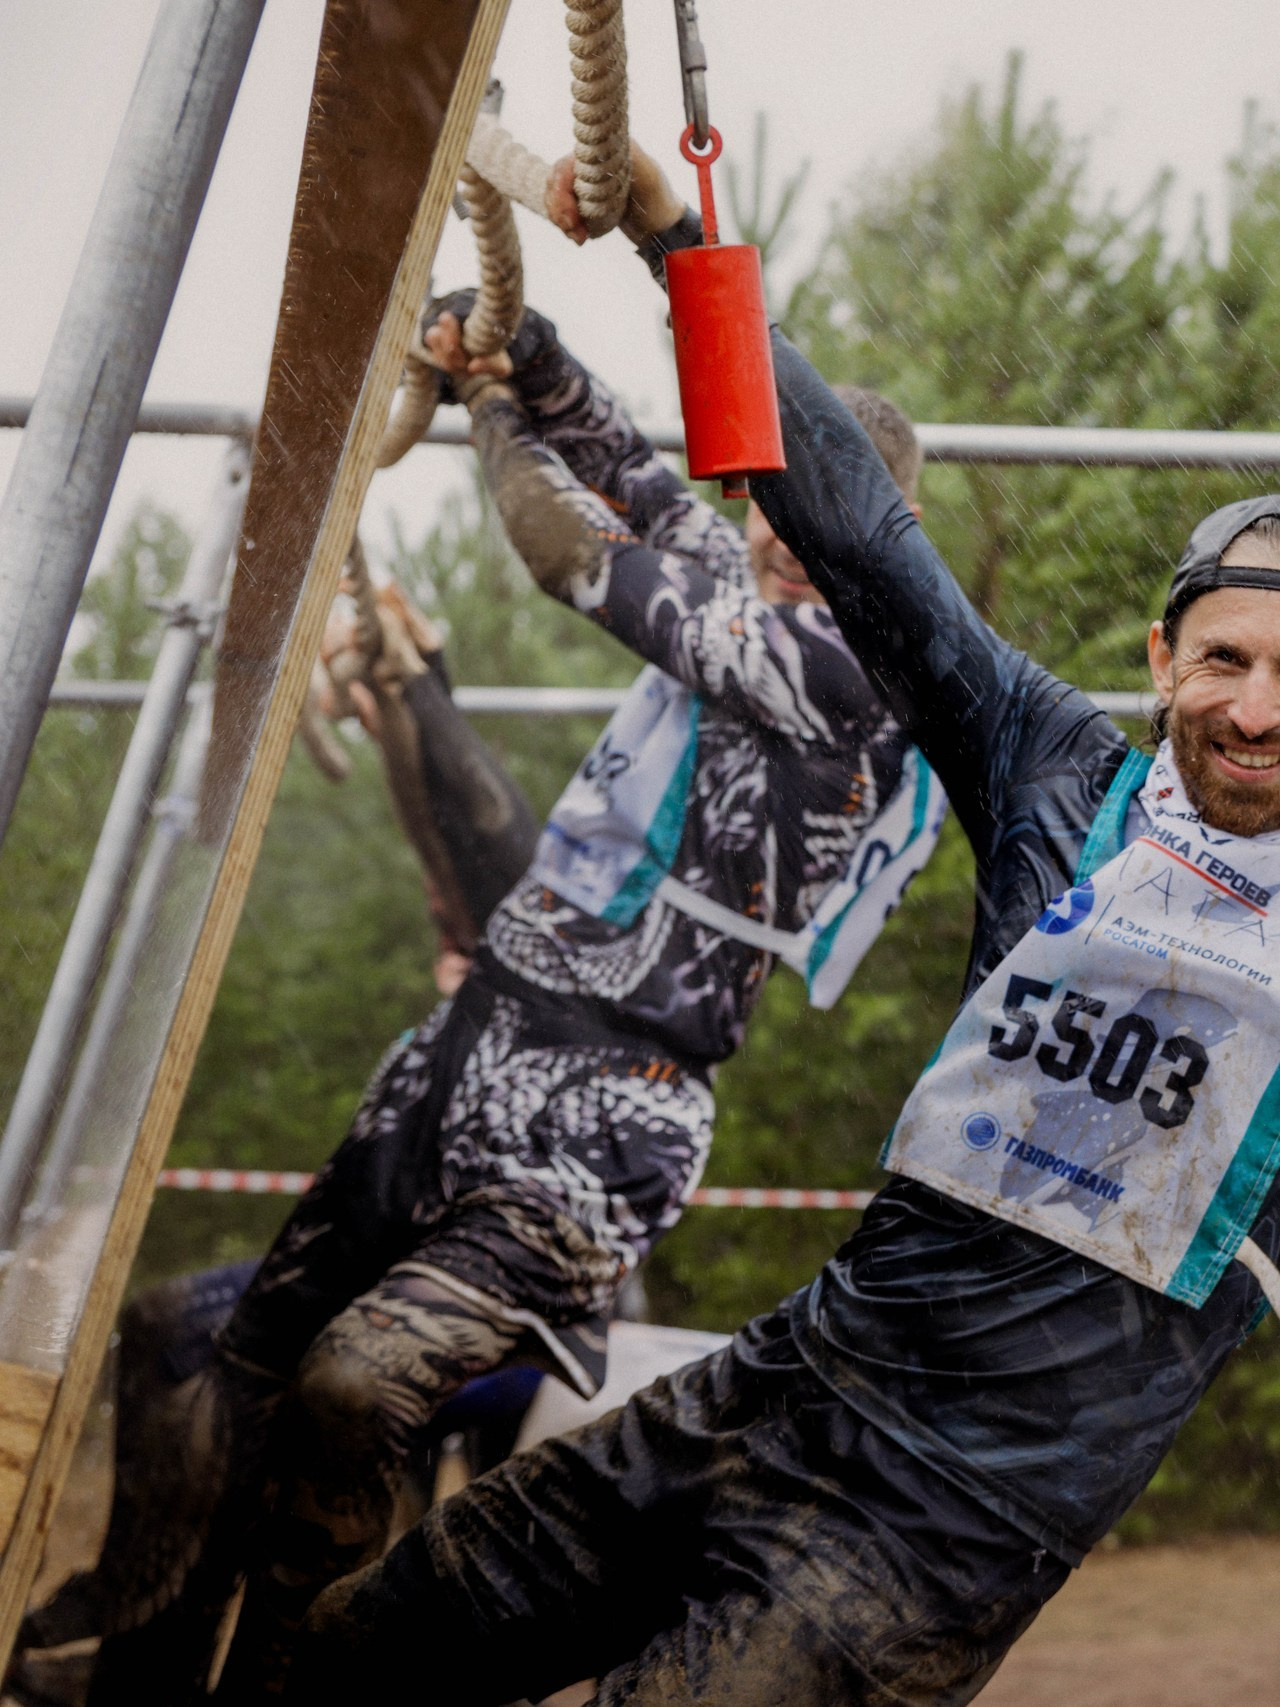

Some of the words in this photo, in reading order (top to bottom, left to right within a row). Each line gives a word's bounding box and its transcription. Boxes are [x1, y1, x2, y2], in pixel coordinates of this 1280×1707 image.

[1195, 850, 1272, 908] ГЕРОЕВ
[1103, 928, 1168, 960] РОСАТОМ
[1112, 916, 1272, 986] АЭМ-ТЕХНОЛОГИИ
[988, 973, 1210, 1130] 5503
[1003, 1136, 1126, 1204] ГАЗПРОМБАНК
